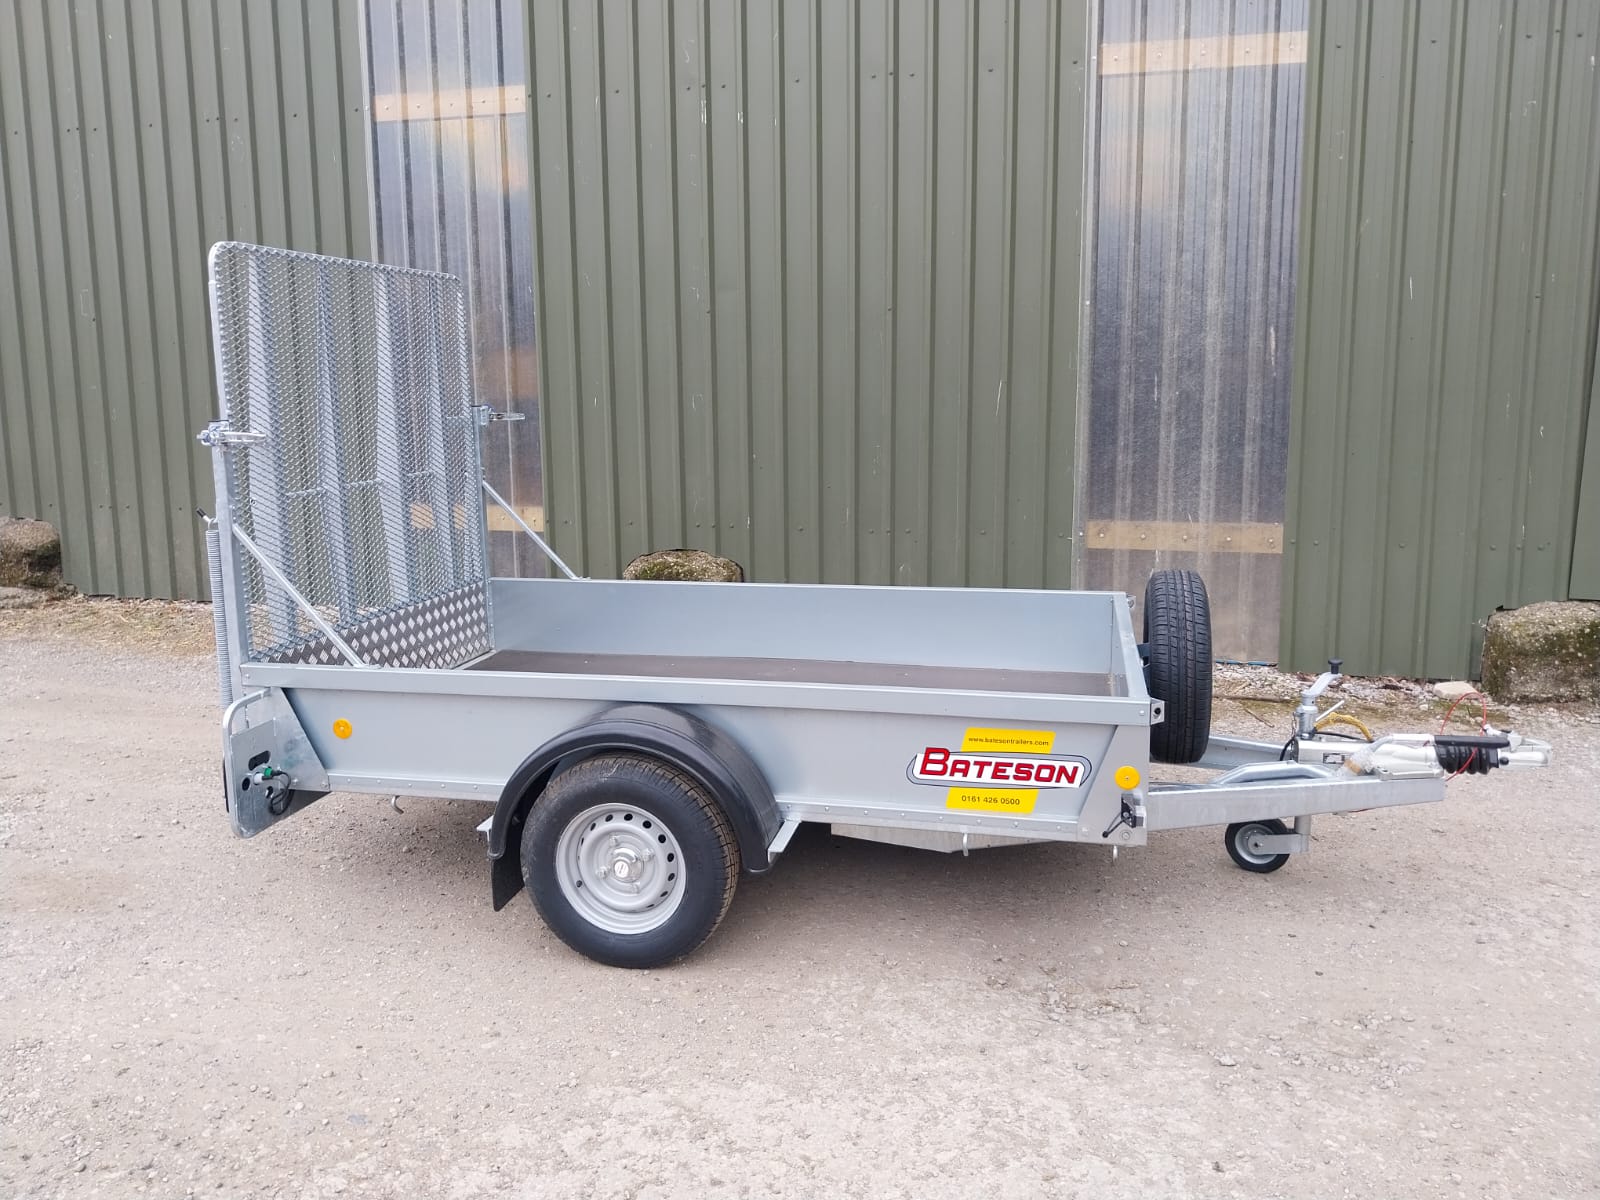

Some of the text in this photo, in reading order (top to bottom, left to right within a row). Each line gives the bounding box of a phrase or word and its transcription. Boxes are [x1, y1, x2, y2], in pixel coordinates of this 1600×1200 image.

[968, 736, 1049, 746] www.batesontrailers.com
[919, 747, 1079, 784] BATESON
[961, 795, 1020, 805] 0161 426 0500
